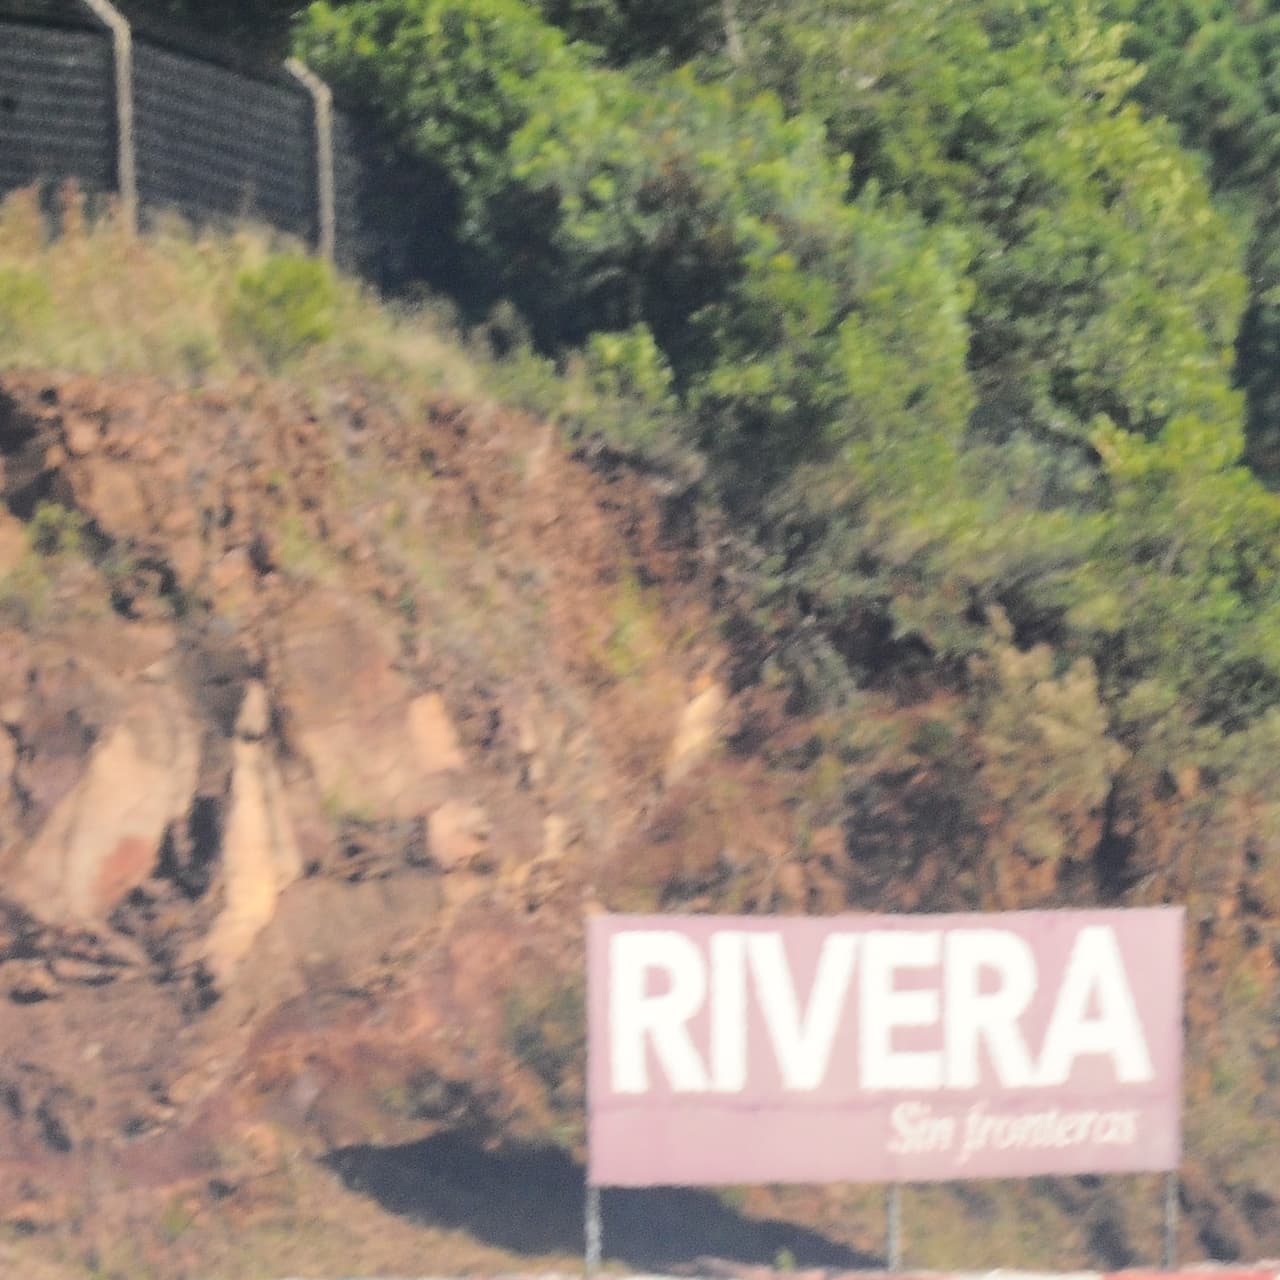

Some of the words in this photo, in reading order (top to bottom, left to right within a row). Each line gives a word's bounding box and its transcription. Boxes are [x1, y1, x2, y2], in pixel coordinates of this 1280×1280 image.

[609, 925, 1154, 1092] RIVERA
[886, 1100, 952, 1154] Sin
[954, 1101, 1140, 1165] fronteras
